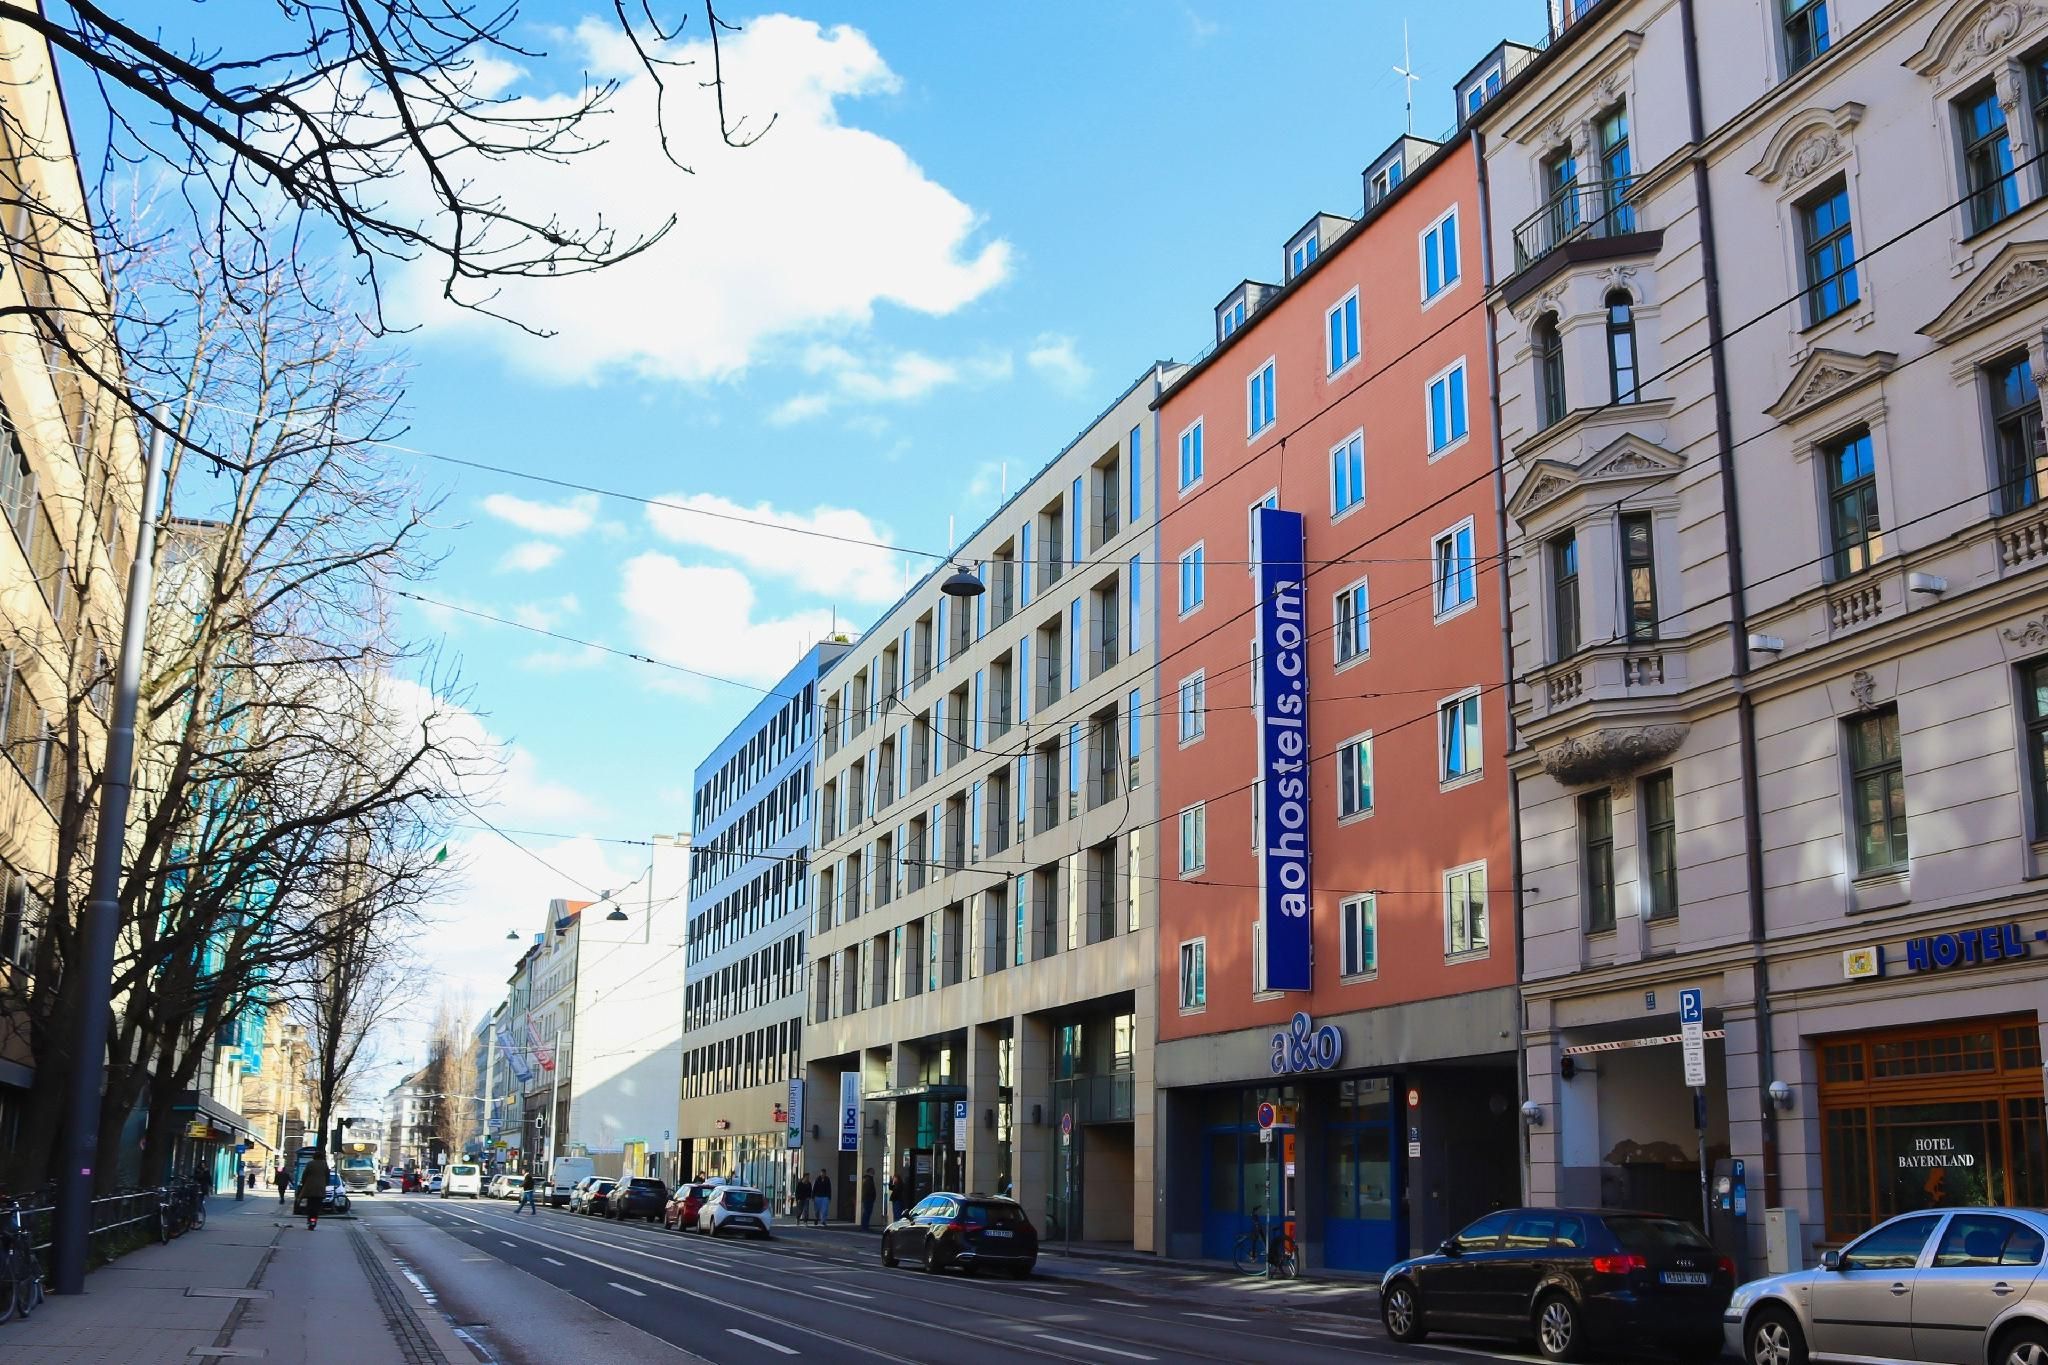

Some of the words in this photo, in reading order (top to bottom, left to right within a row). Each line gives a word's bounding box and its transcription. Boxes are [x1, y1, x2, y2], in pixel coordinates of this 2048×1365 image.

[1267, 580, 1306, 918] aohostels.com
[1907, 923, 2025, 970] HOTEL
[1683, 994, 1694, 1019] P
[1271, 1011, 1342, 1074] a&o
[843, 1108, 856, 1130] iba
[956, 1103, 964, 1117] P
[1915, 1138, 1955, 1151] HOTEL
[1898, 1154, 1975, 1168] BAYERNLAND
